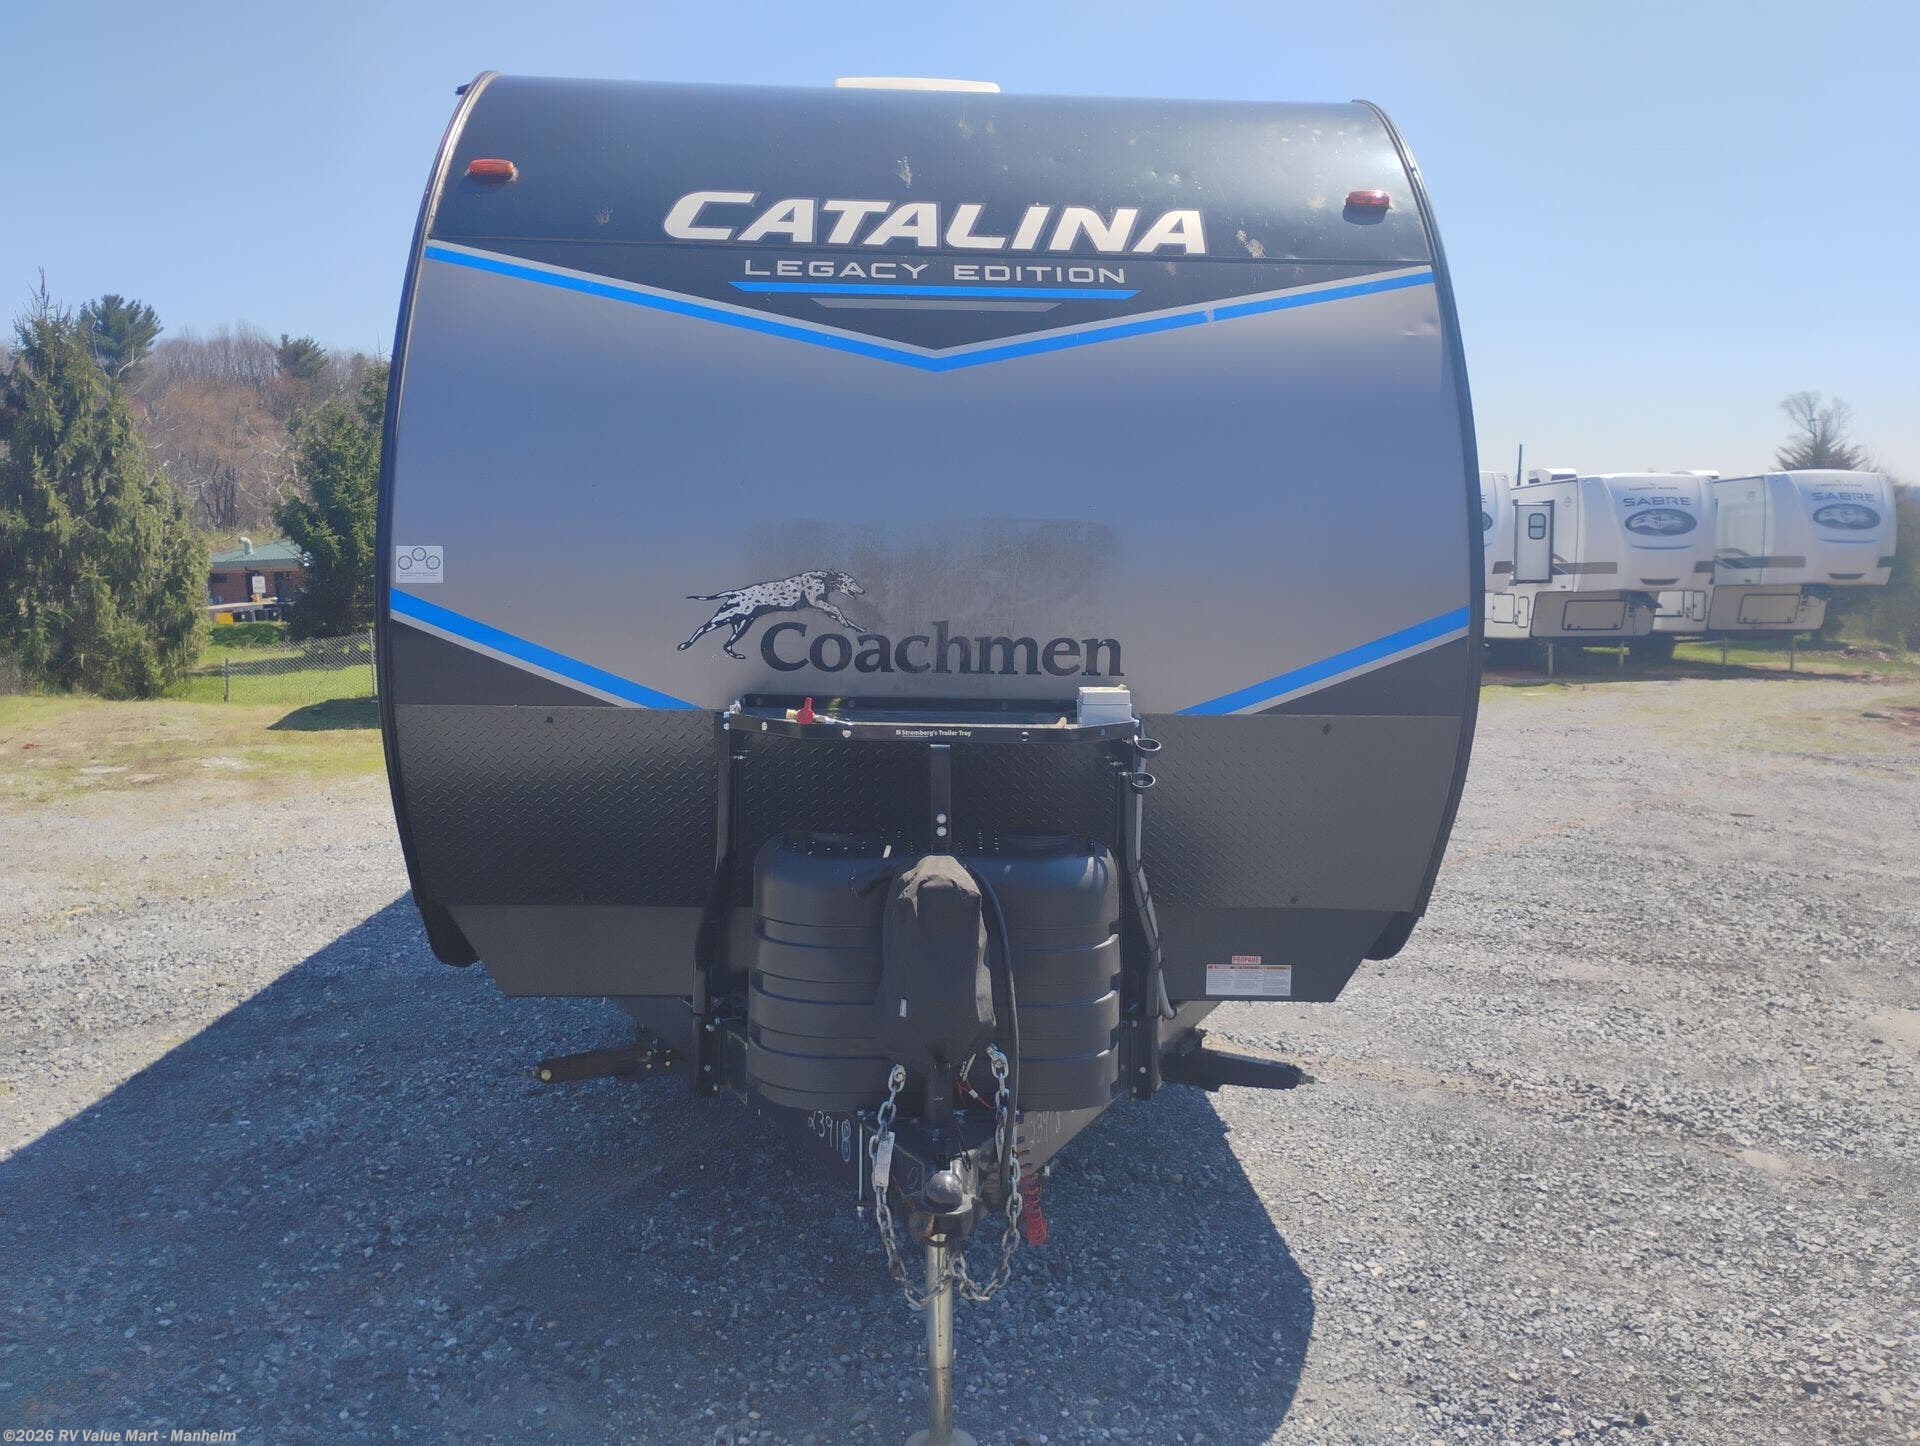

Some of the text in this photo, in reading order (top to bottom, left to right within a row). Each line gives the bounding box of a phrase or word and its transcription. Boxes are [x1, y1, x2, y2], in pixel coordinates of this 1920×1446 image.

[662, 191, 1207, 255] CATALINA
[744, 259, 1126, 284] LEGACY EDITION
[1623, 496, 1691, 507] SABRE
[1811, 492, 1874, 502] SABRE
[760, 620, 1125, 677] Coachmen
[938, 729, 958, 737] Trailer
[958, 729, 972, 737] Tray
